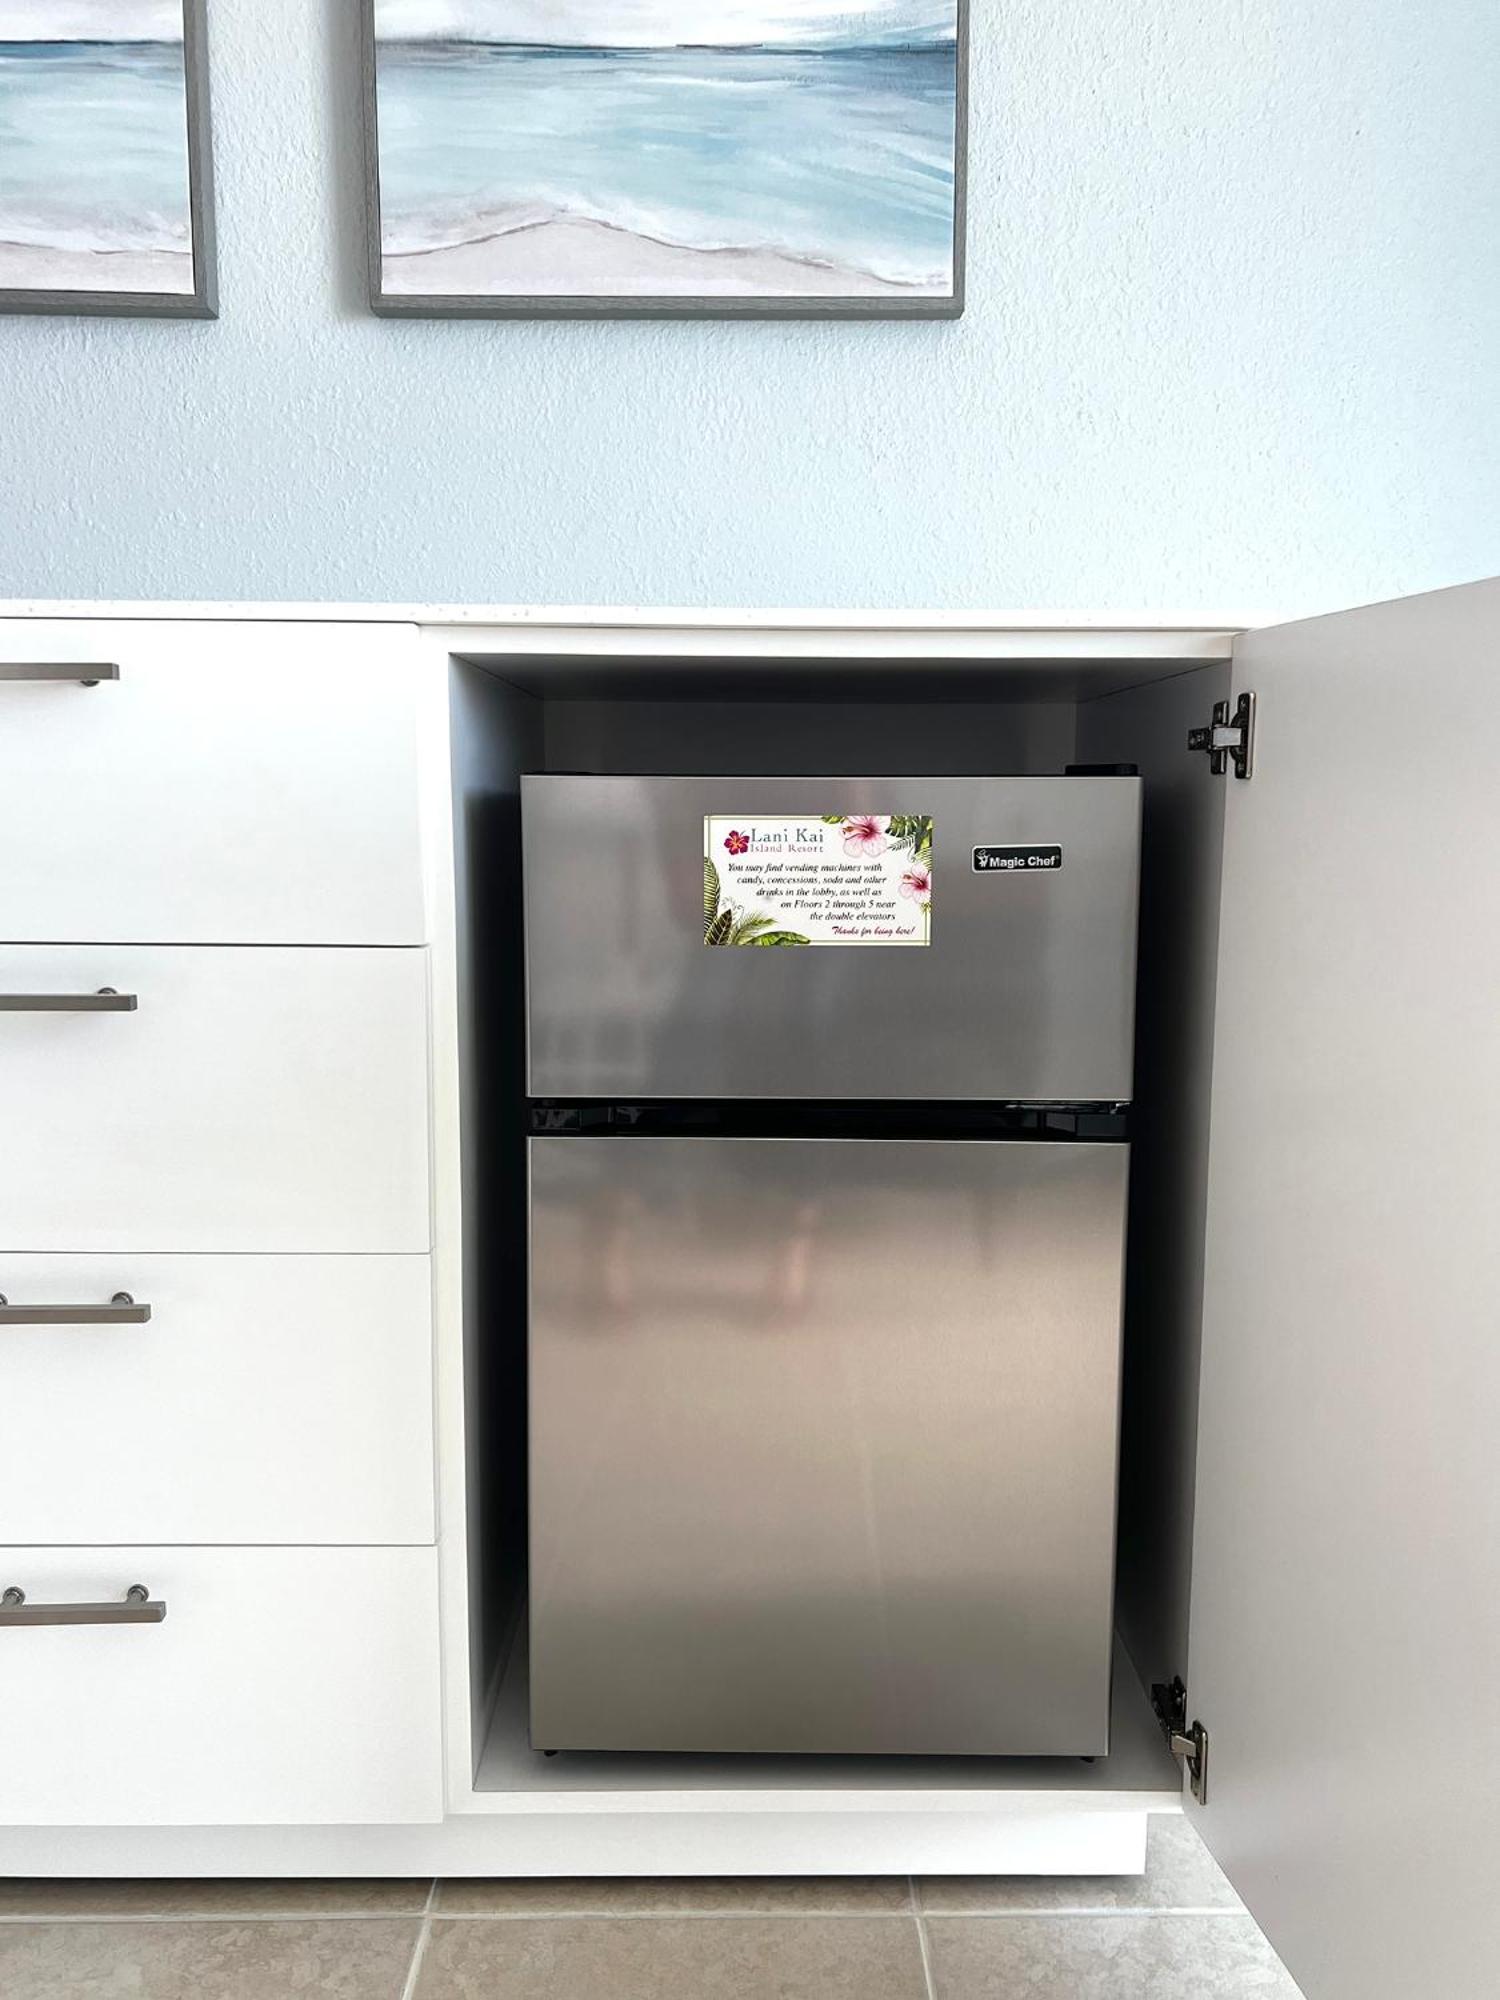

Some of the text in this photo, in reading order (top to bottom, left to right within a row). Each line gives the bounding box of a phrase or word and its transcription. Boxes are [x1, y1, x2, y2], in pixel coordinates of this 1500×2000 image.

[751, 828, 824, 842] Lani Kai
[750, 844, 823, 852] Island Resort
[989, 856, 1055, 869] Magic Chef
[728, 863, 883, 874] You may find vending machines with
[823, 876, 843, 884] soda
[846, 875, 861, 883] and
[864, 875, 887, 883] other
[756, 888, 783, 896] drinks
[786, 888, 794, 896] in
[796, 888, 809, 896] the
[852, 887, 869, 896] well
[794, 900, 822, 908] Floors
[825, 900, 830, 908] 2
[833, 900, 866, 910] through
[869, 900, 874, 908] 5
[810, 912, 895, 920] the double elevators
[832, 926, 859, 934] Thanks
